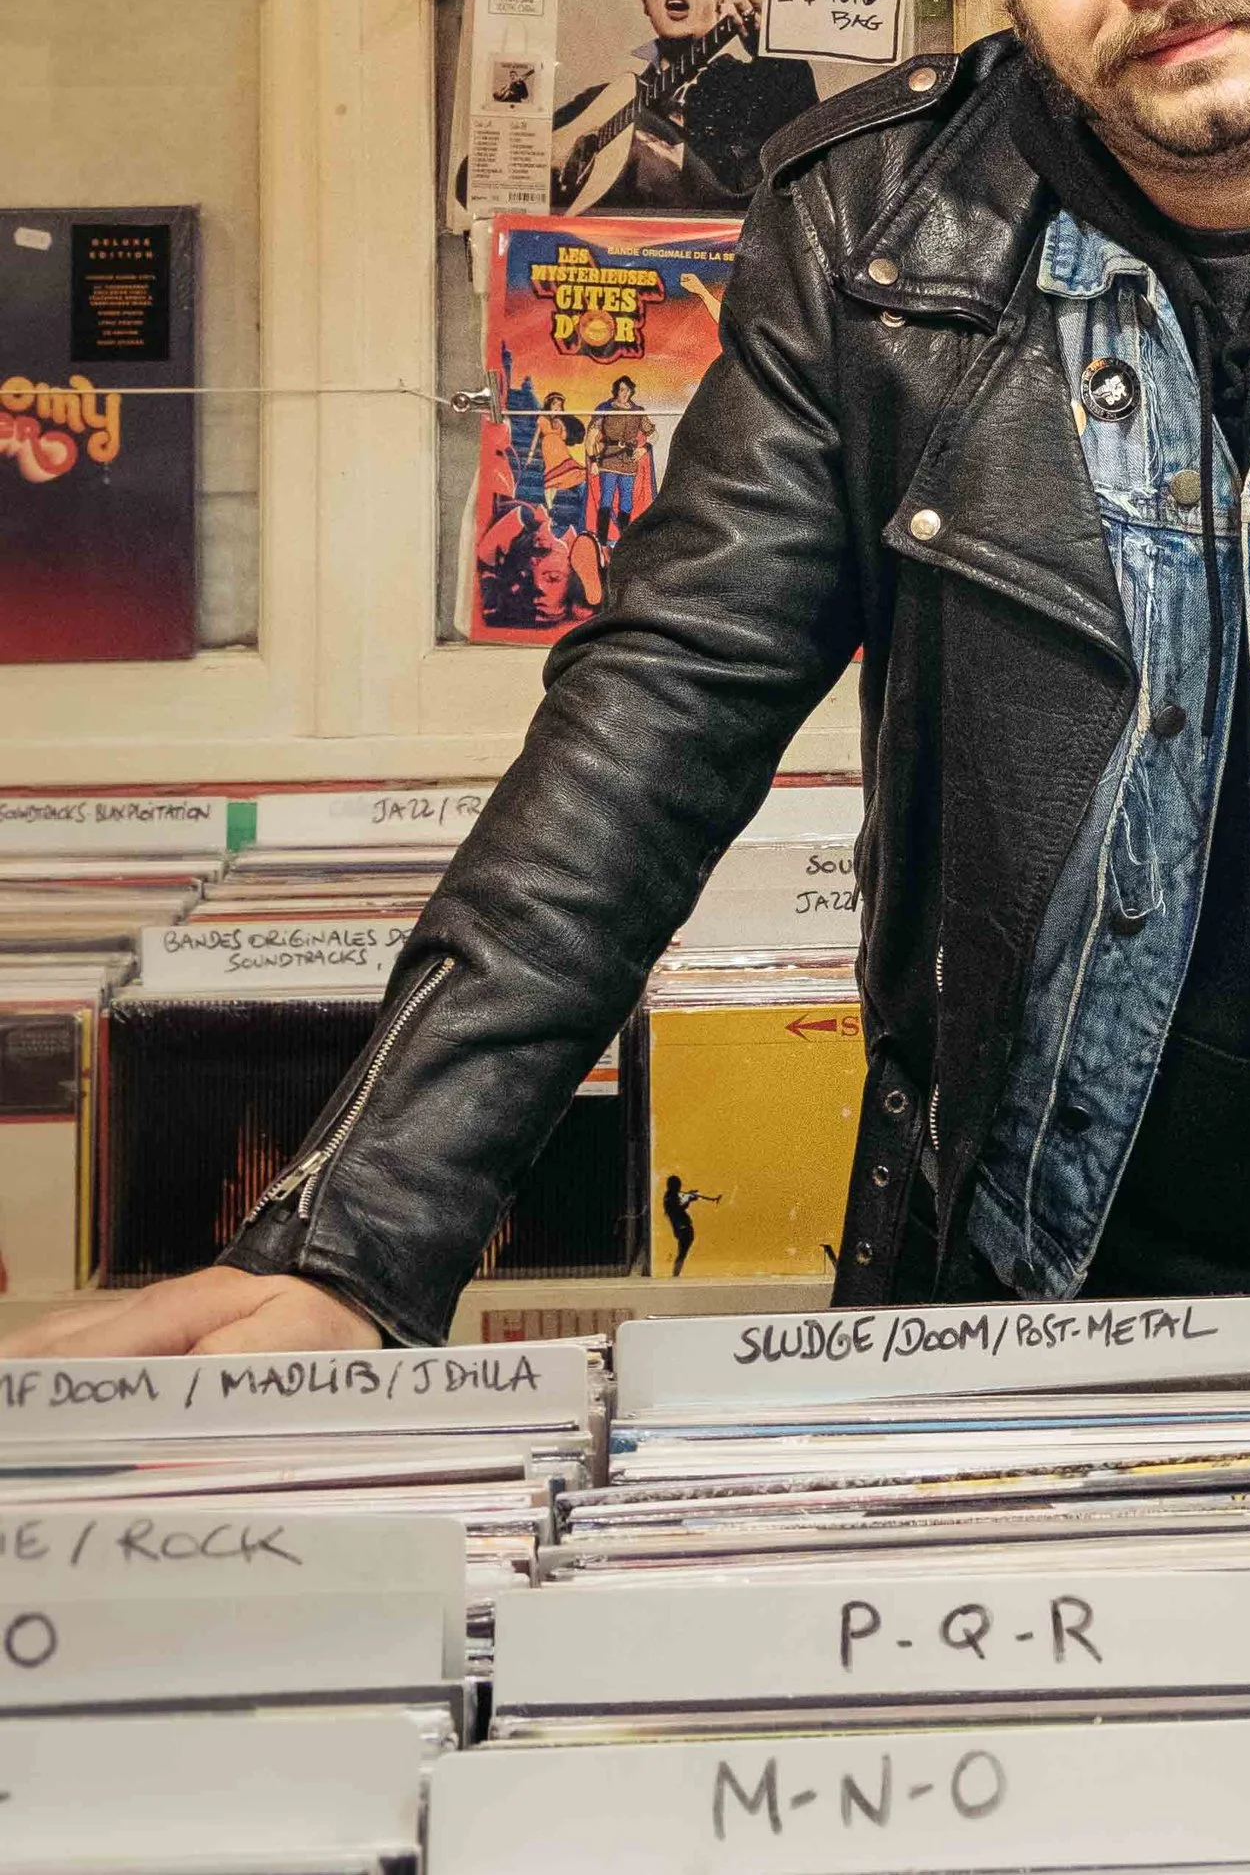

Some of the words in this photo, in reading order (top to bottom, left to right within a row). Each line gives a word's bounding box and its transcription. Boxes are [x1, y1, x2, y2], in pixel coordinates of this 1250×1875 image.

[831, 11, 883, 31] BAG
[88, 250, 154, 260] EDITION
[558, 246, 591, 265] LES
[607, 246, 640, 257] BANDE
[642, 248, 692, 260] ORIGINALE
[693, 251, 707, 261] DE
[708, 251, 721, 261] LA
[530, 263, 658, 287] MYSTERIEUSES
[555, 284, 638, 313] CITES
[163, 929, 241, 954] BANDES
[49, 1366, 160, 1408] DOOM
[116, 1525, 303, 1566] ROCK
